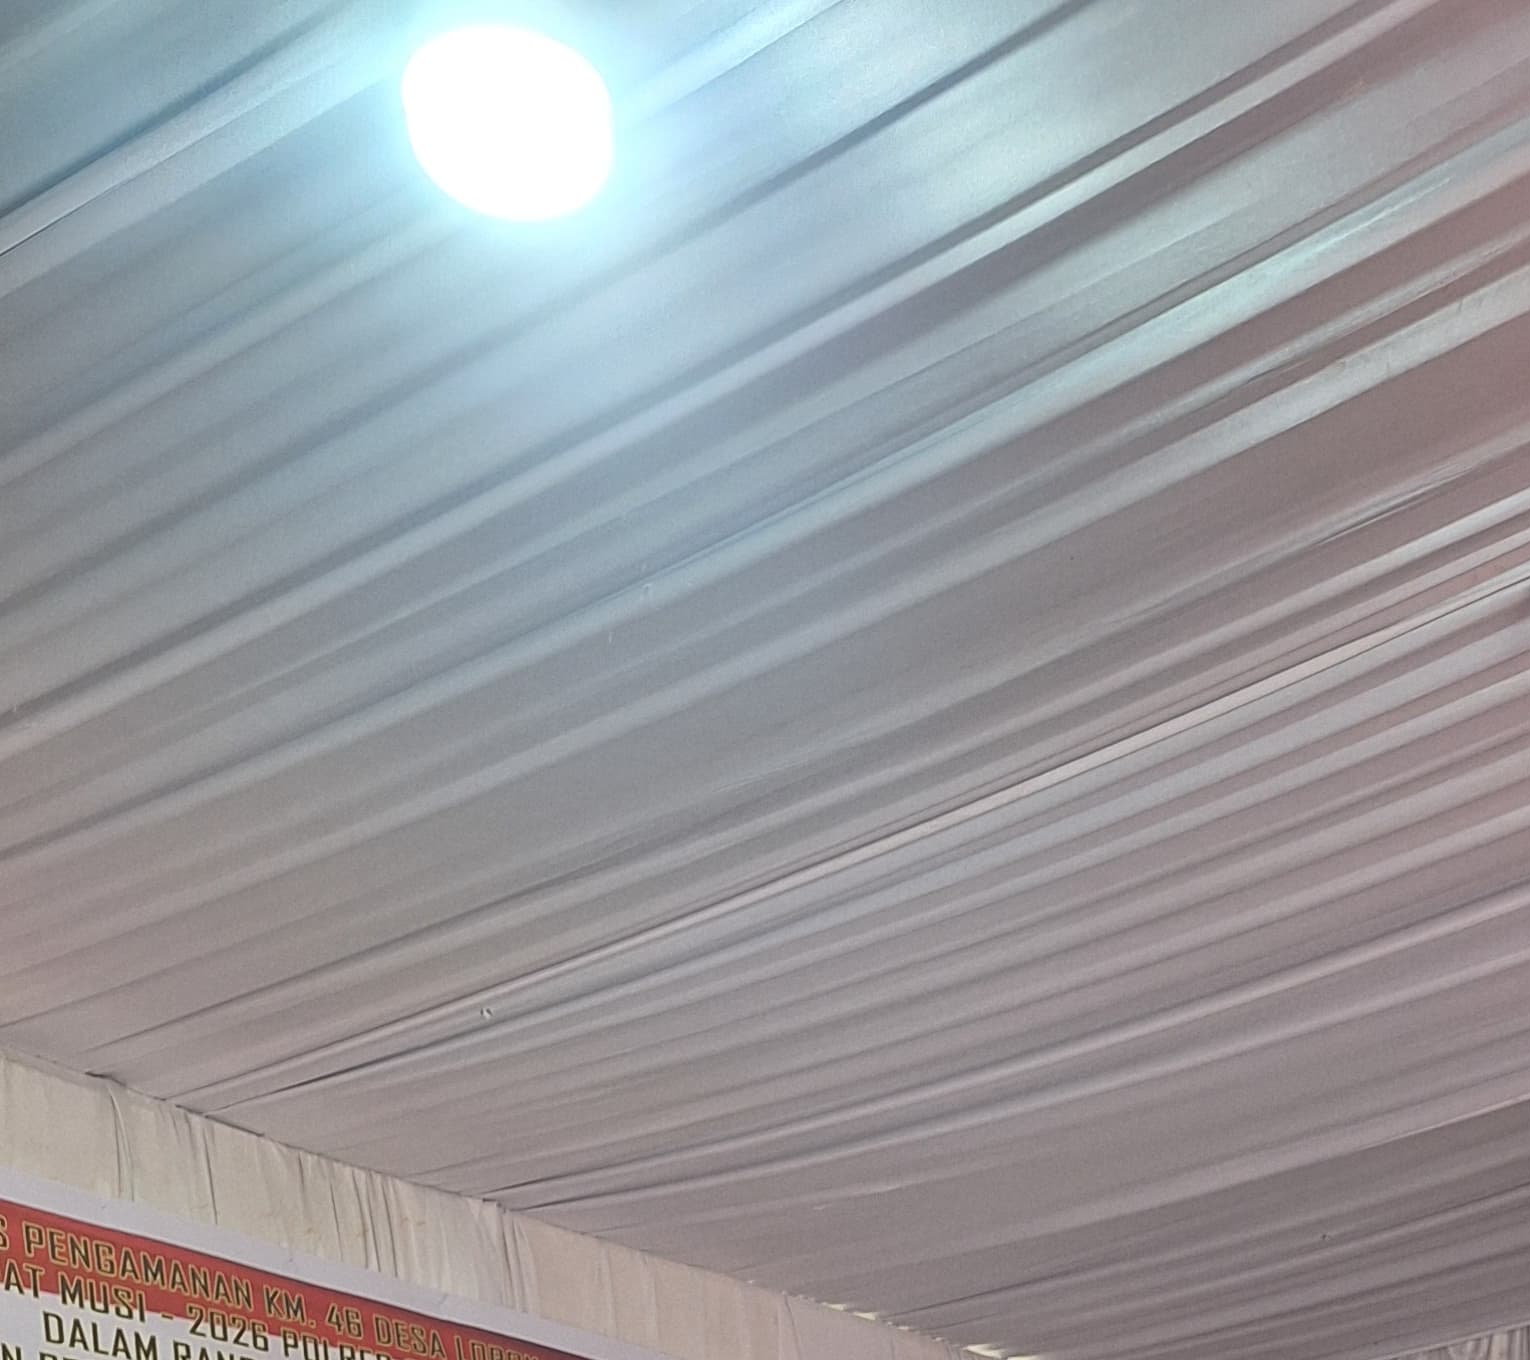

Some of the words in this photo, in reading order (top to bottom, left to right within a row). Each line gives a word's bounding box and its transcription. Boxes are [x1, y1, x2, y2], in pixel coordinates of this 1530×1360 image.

[22, 1221, 252, 1310] PENGAMANAN
[263, 1285, 317, 1328] KM.
[326, 1303, 364, 1340] 46
[375, 1314, 447, 1360] DESA
[58, 1272, 148, 1324] MUSI
[187, 1303, 270, 1353] 2026
